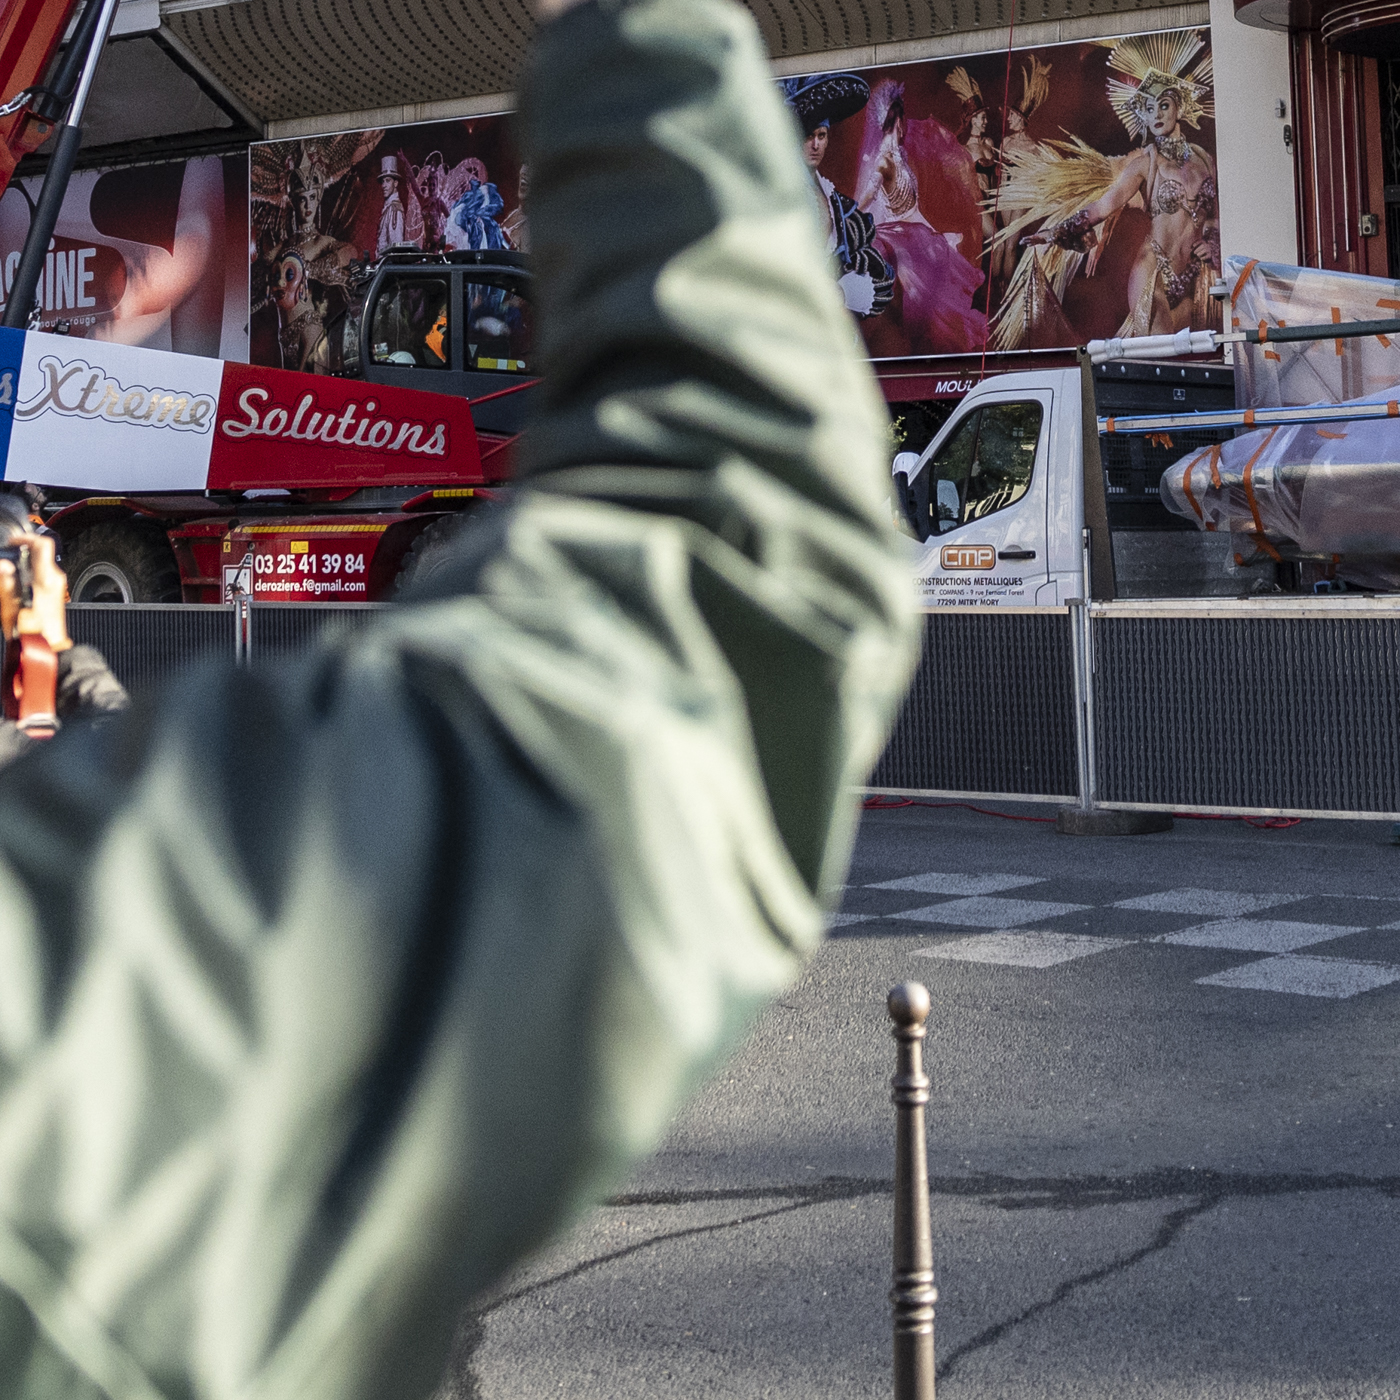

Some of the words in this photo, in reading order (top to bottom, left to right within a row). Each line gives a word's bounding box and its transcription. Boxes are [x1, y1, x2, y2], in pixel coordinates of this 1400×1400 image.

[935, 379, 983, 394] MOUL
[16, 362, 211, 428] Xtreme
[222, 387, 446, 456] Solutions
[255, 554, 274, 574] 03
[277, 554, 296, 574] 25
[299, 554, 317, 574] 41
[321, 554, 342, 574] 39
[344, 553, 366, 574] 84
[944, 549, 992, 566] CMP
[254, 578, 366, 595] deroziere.f@gmail.com
[973, 577, 1023, 587] METALLIQUES
[958, 598, 978, 606] MITRY
